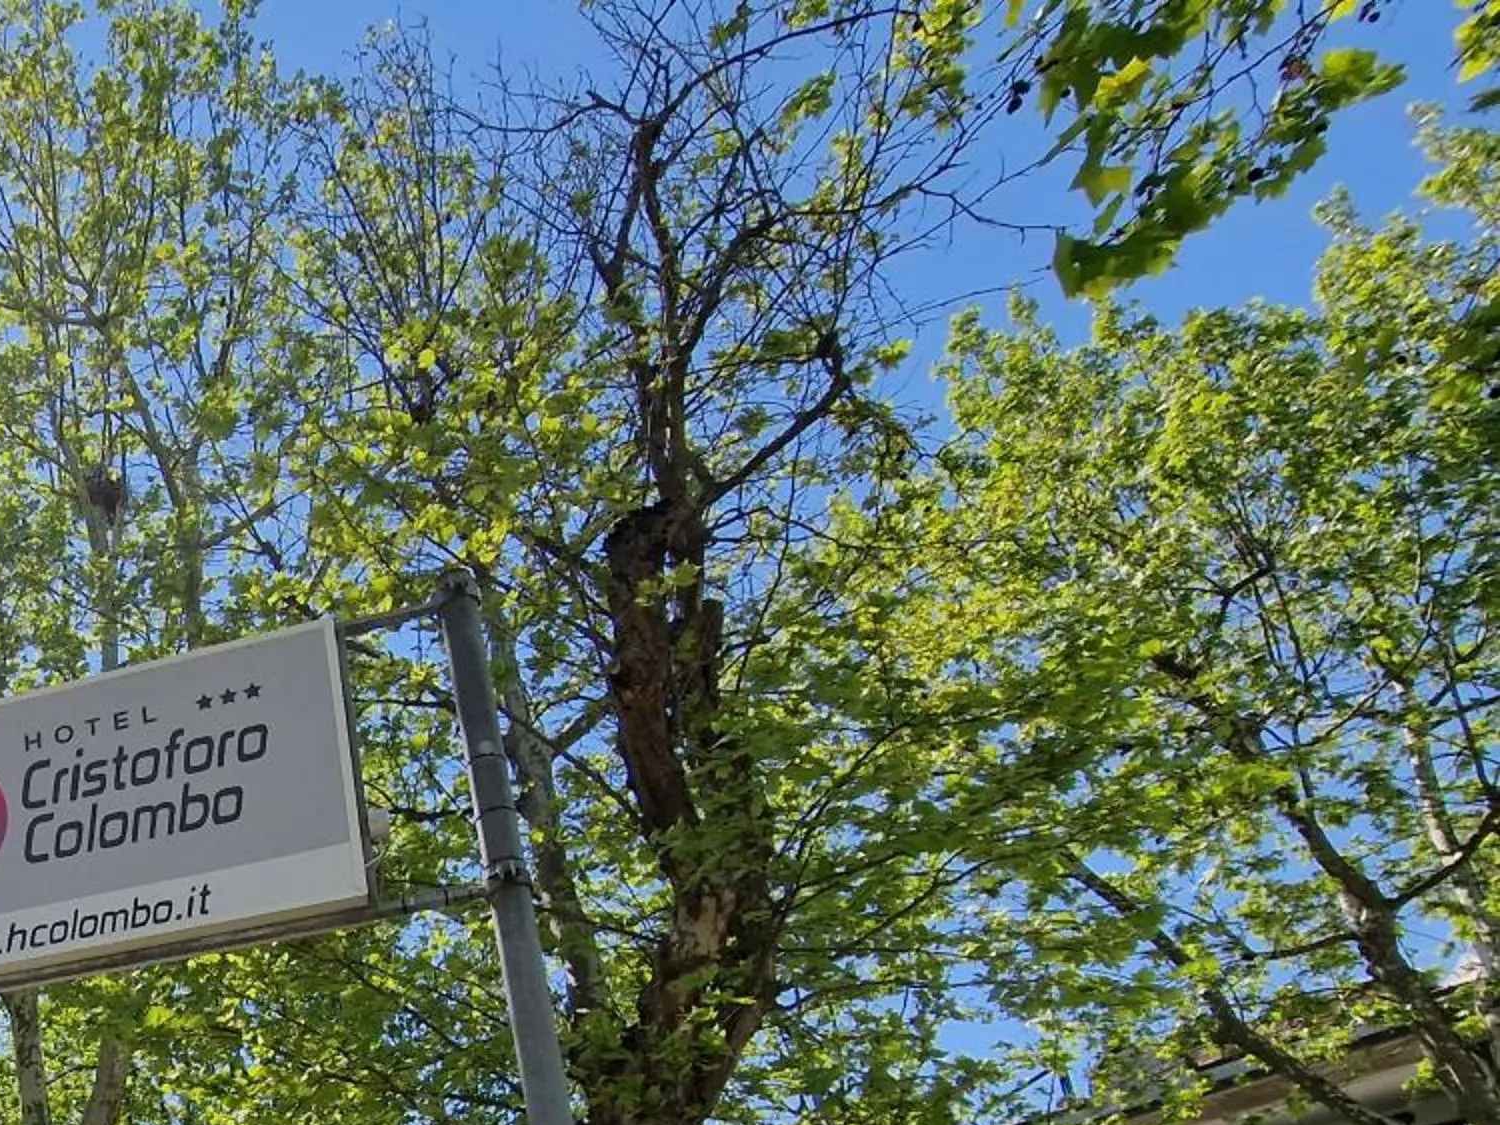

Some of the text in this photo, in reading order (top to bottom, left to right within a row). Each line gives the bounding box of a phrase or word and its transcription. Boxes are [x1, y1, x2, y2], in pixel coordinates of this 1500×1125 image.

[21, 723, 269, 809] Cristoforo
[24, 706, 159, 752] HOTEL
[24, 784, 244, 864] Colombo
